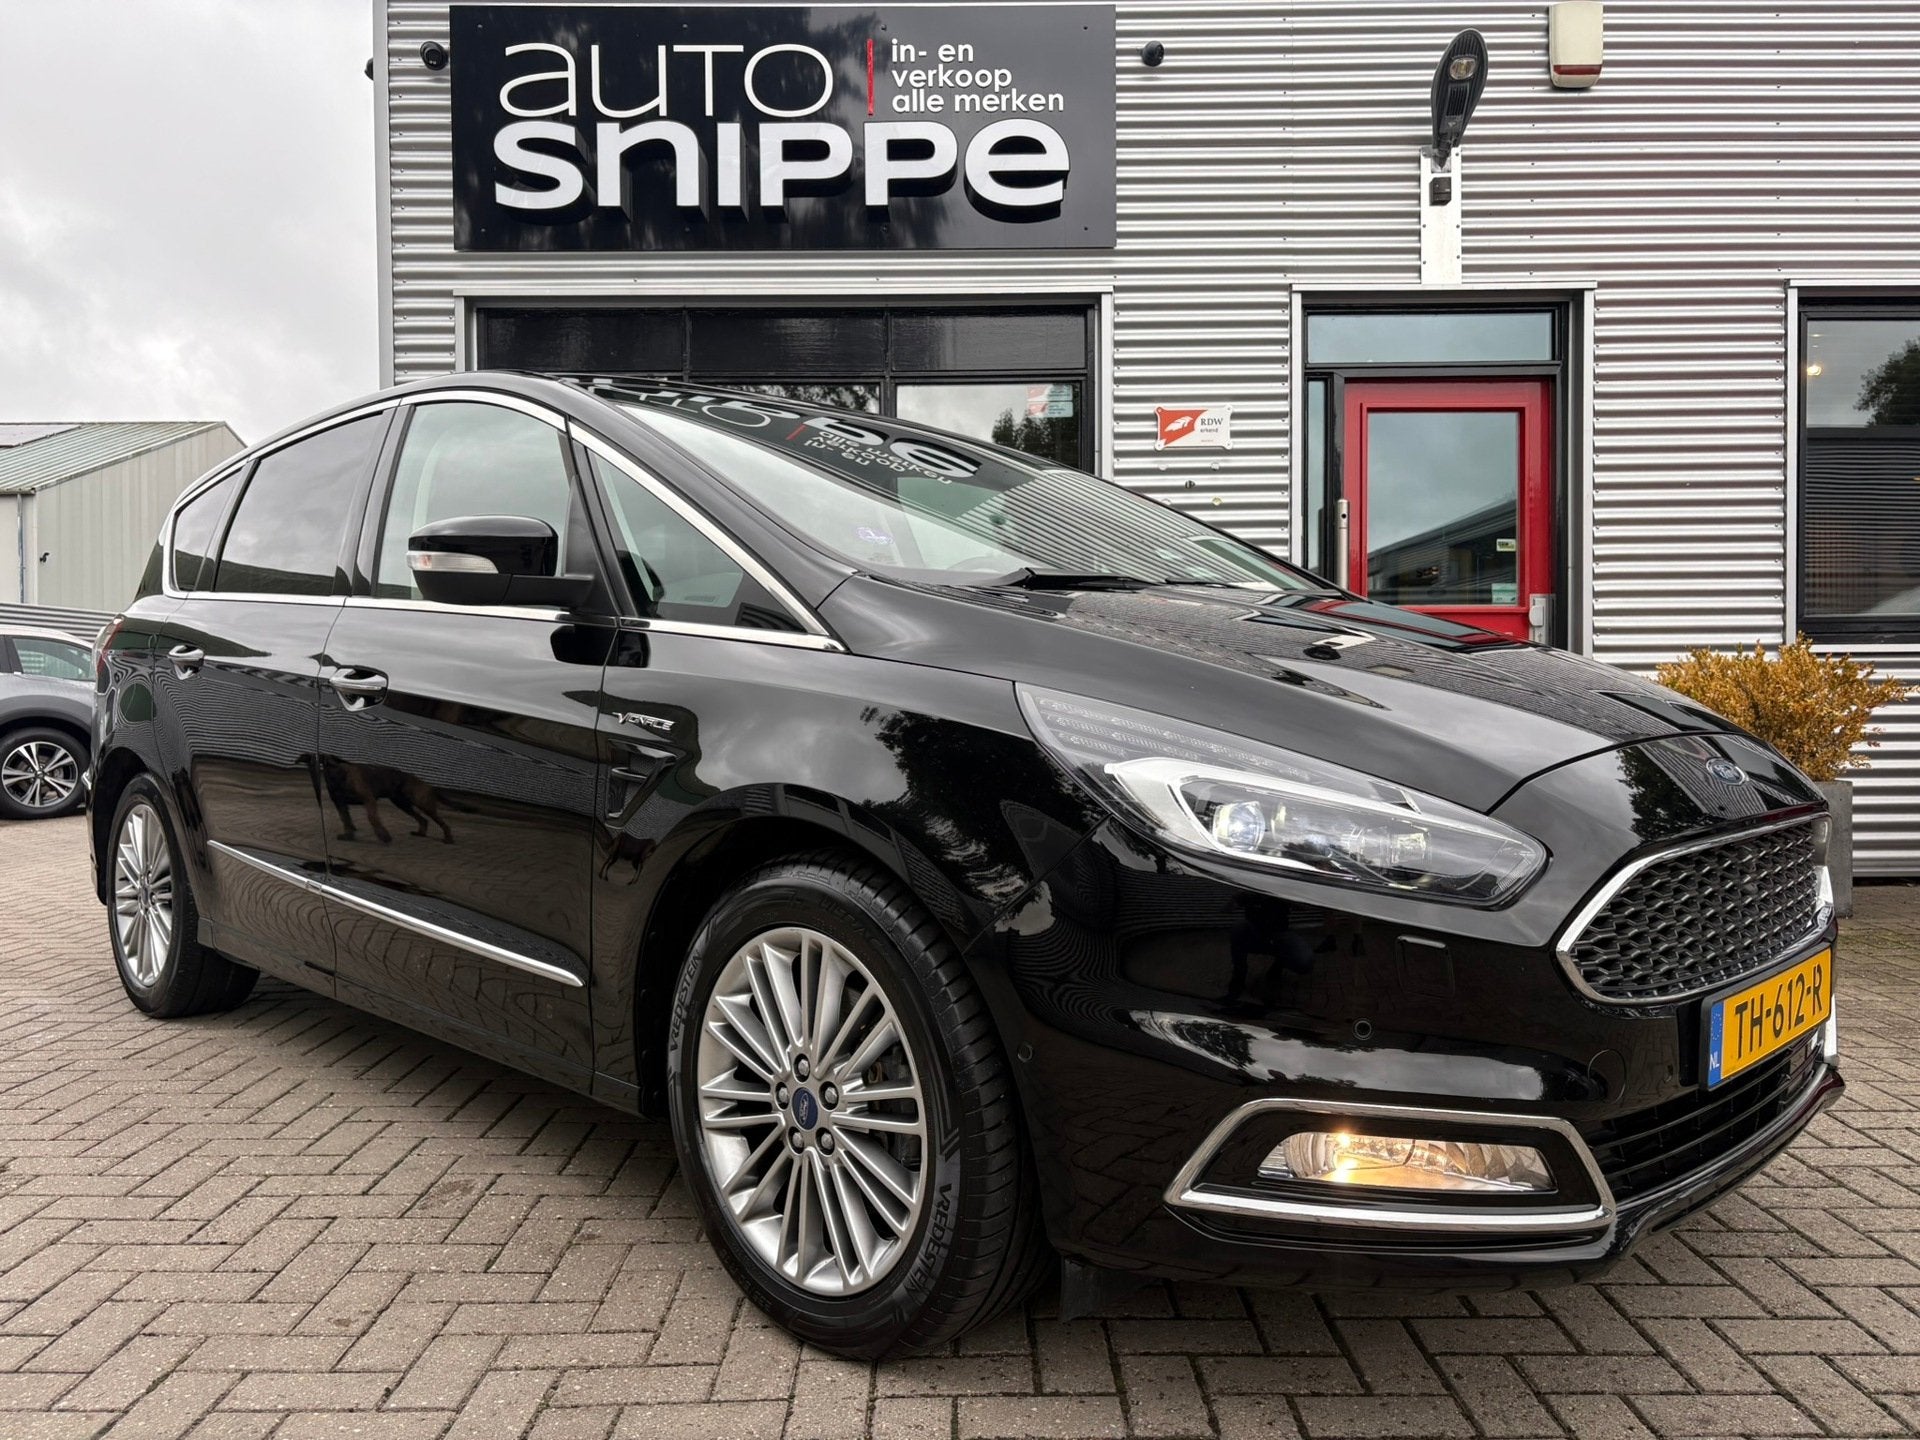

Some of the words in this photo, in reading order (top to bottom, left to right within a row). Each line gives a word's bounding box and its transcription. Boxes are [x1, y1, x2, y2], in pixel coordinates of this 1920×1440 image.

[891, 38, 928, 63] in-
[937, 43, 974, 63] en
[891, 64, 1013, 92] verkoop
[892, 88, 945, 113] alle
[954, 87, 1064, 112] merken
[1200, 417, 1223, 426] RDW
[669, 948, 703, 1052] VREDESTEIN
[1735, 963, 1823, 1060] TH-612-R
[1709, 1051, 1720, 1070] NL
